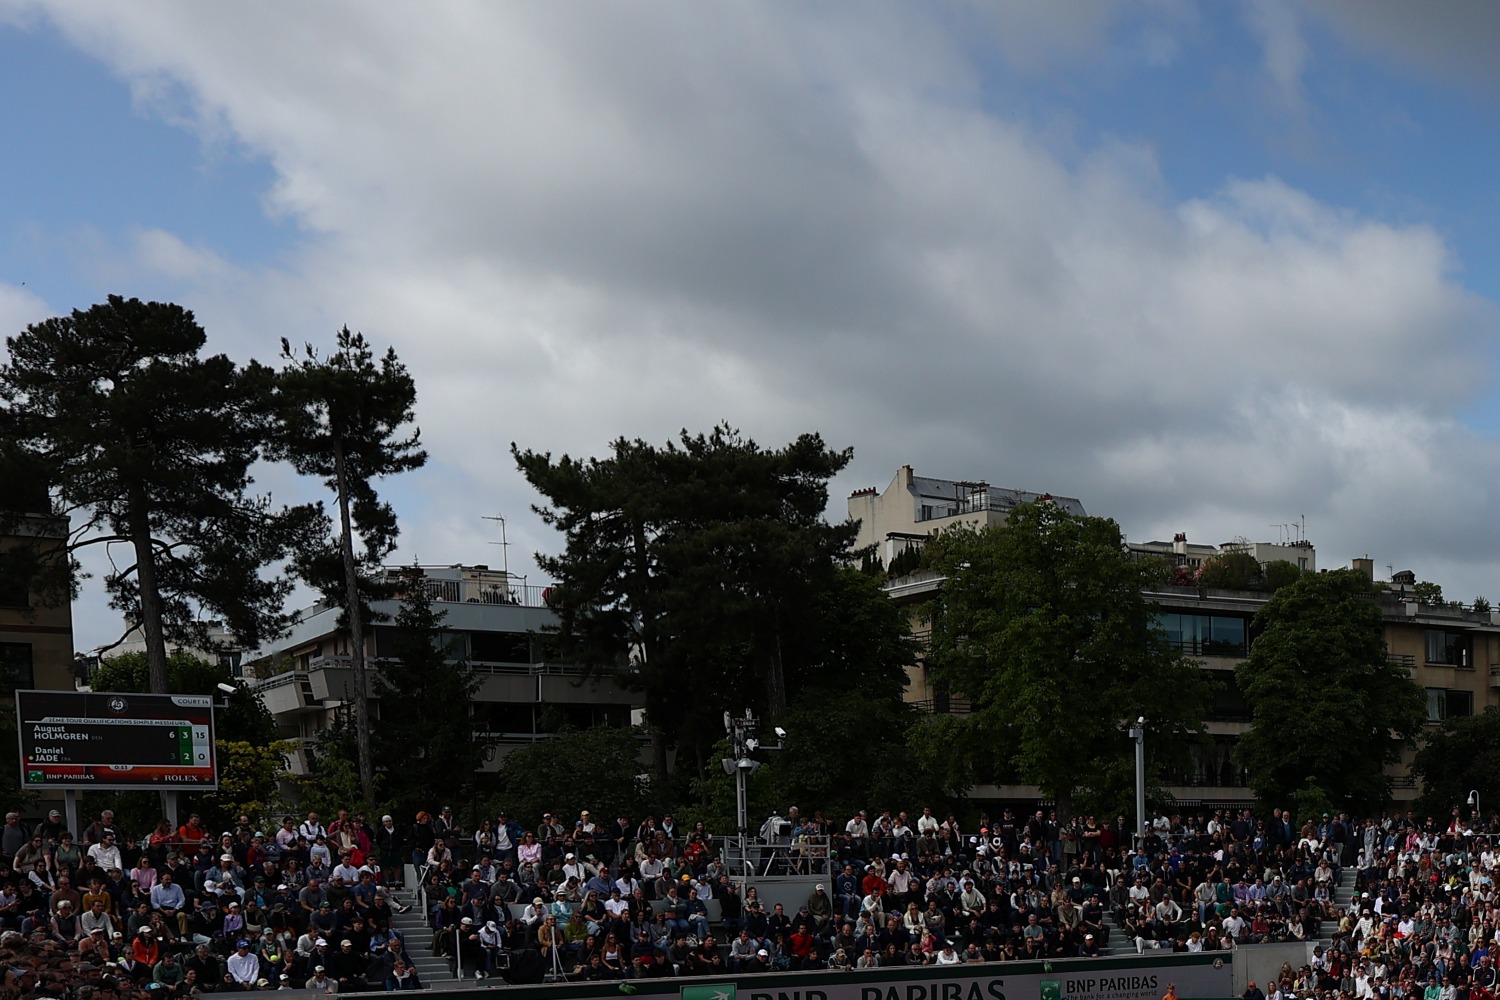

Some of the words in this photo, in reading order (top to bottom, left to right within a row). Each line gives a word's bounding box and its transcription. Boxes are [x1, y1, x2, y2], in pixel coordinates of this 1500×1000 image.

[34, 724, 66, 733] August
[34, 732, 89, 740] HOLMGREN
[35, 746, 64, 754] Daniel
[35, 754, 58, 762] JADE
[164, 774, 198, 782] ROLEX
[1066, 979, 1096, 994] BNP
[1100, 975, 1158, 991] PARIBAS
[1096, 992, 1104, 1000] for
[1112, 991, 1139, 1000] changing
